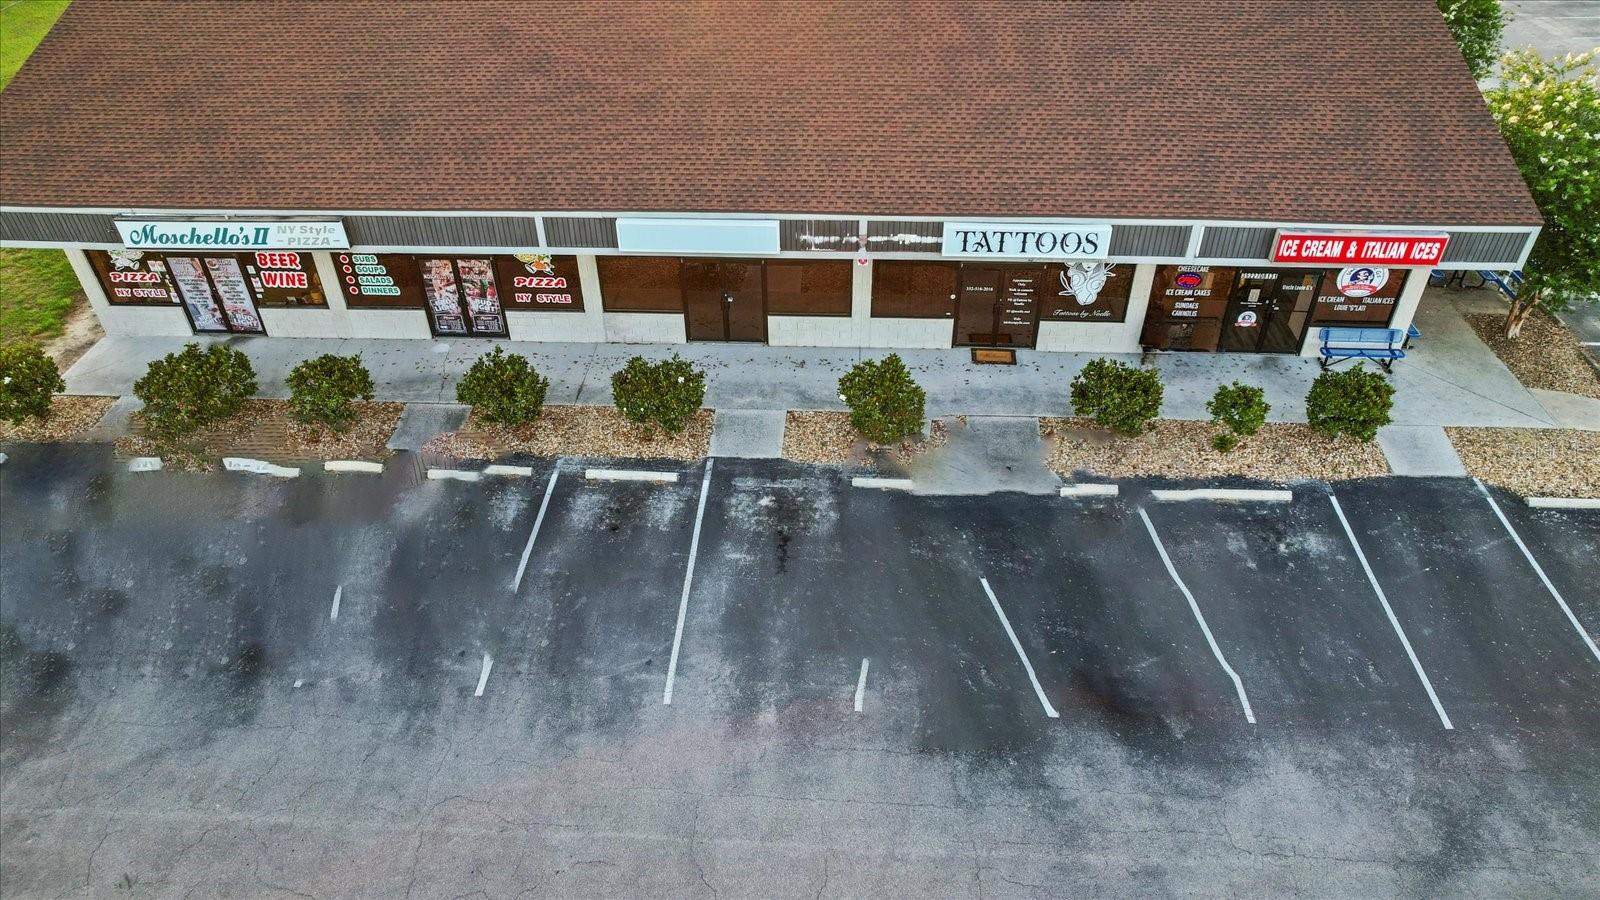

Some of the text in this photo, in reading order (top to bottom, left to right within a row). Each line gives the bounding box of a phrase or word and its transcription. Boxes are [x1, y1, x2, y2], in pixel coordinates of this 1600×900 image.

[130, 224, 270, 246] Moschello's II
[277, 225, 335, 236] NY Style
[288, 236, 331, 246] PIZZA
[956, 230, 1099, 254] TATTOOS
[1278, 240, 1440, 260] ICE CREAM & ITALIAN ICES
[256, 252, 302, 270] BEER
[352, 255, 377, 264] SUBS
[356, 265, 386, 274] SOUPS
[110, 272, 161, 283] PIZZA
[262, 272, 308, 288] WINE
[358, 276, 394, 285] SALADS
[514, 277, 567, 288] PIZZA
[115, 288, 168, 298] NY STYLE
[362, 286, 400, 295] DINNERS
[516, 294, 572, 304] NY STYLE
